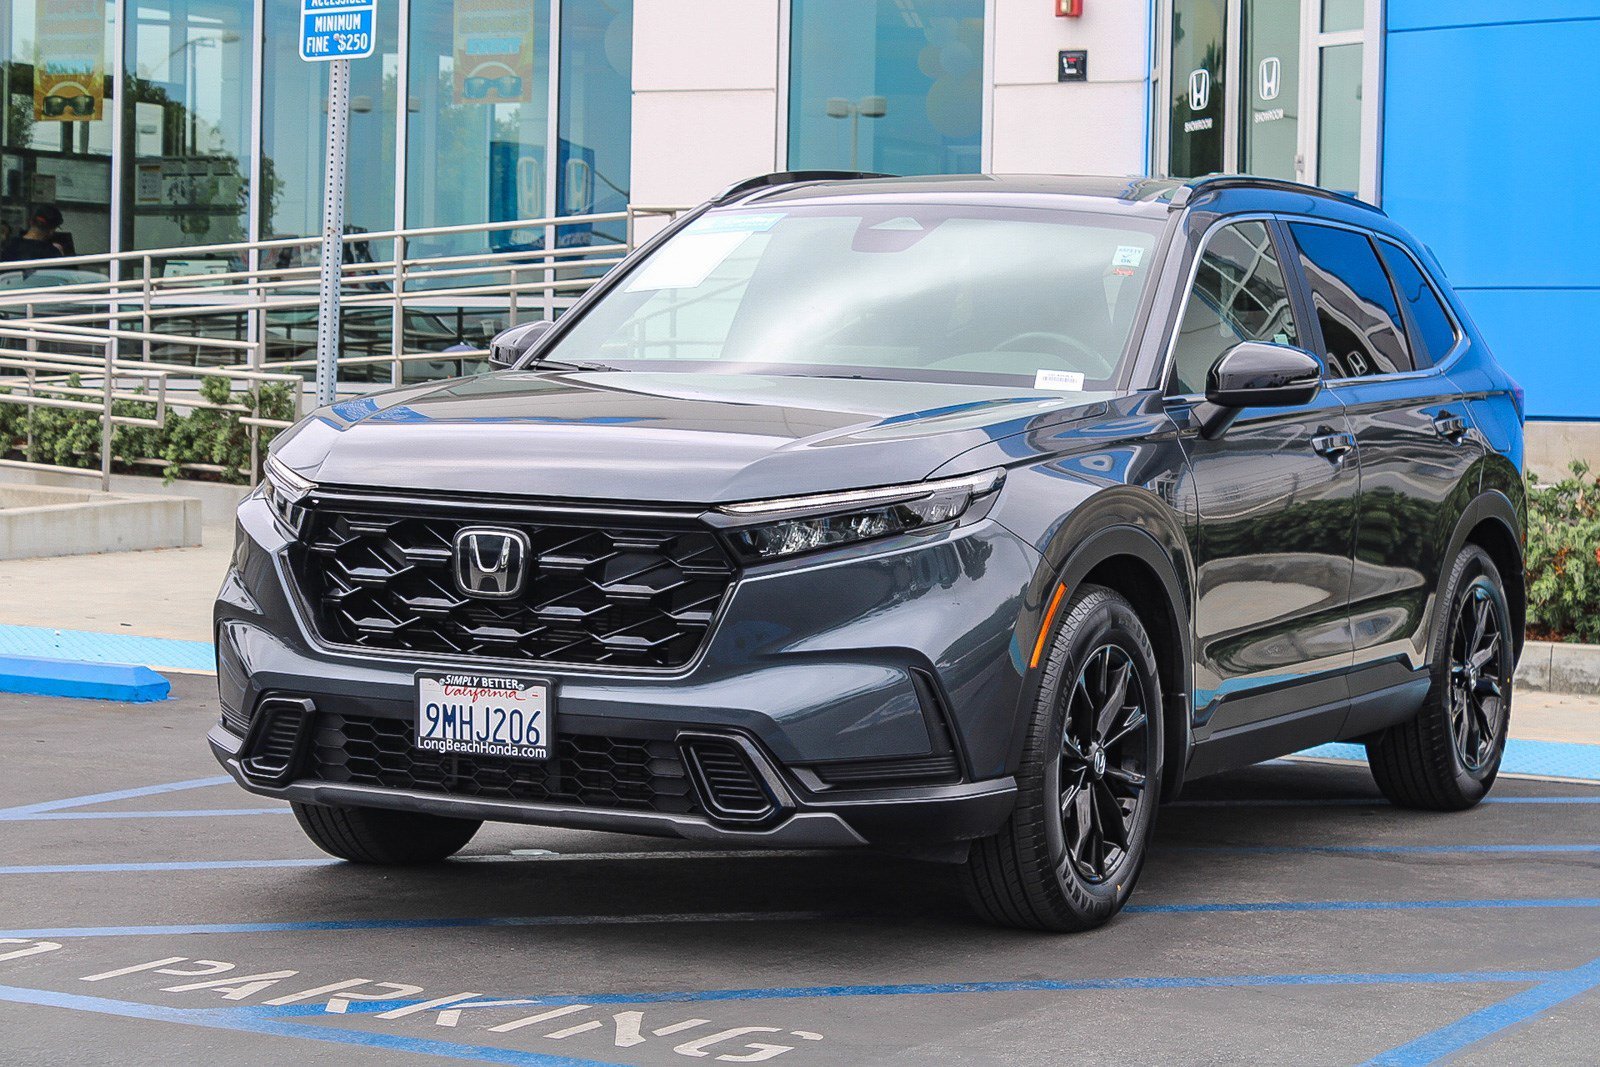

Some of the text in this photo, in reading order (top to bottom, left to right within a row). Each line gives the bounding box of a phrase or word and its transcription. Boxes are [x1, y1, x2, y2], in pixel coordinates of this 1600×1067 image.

[314, 14, 361, 33] MINIMUM
[306, 32, 368, 53] FINE $250
[444, 674, 519, 690] SIMPLY BETTER
[443, 684, 527, 703] California
[425, 703, 541, 746] 9MHJ206
[417, 736, 547, 759] LongBeachHonda.com
[79, 956, 824, 1062] PARKING
